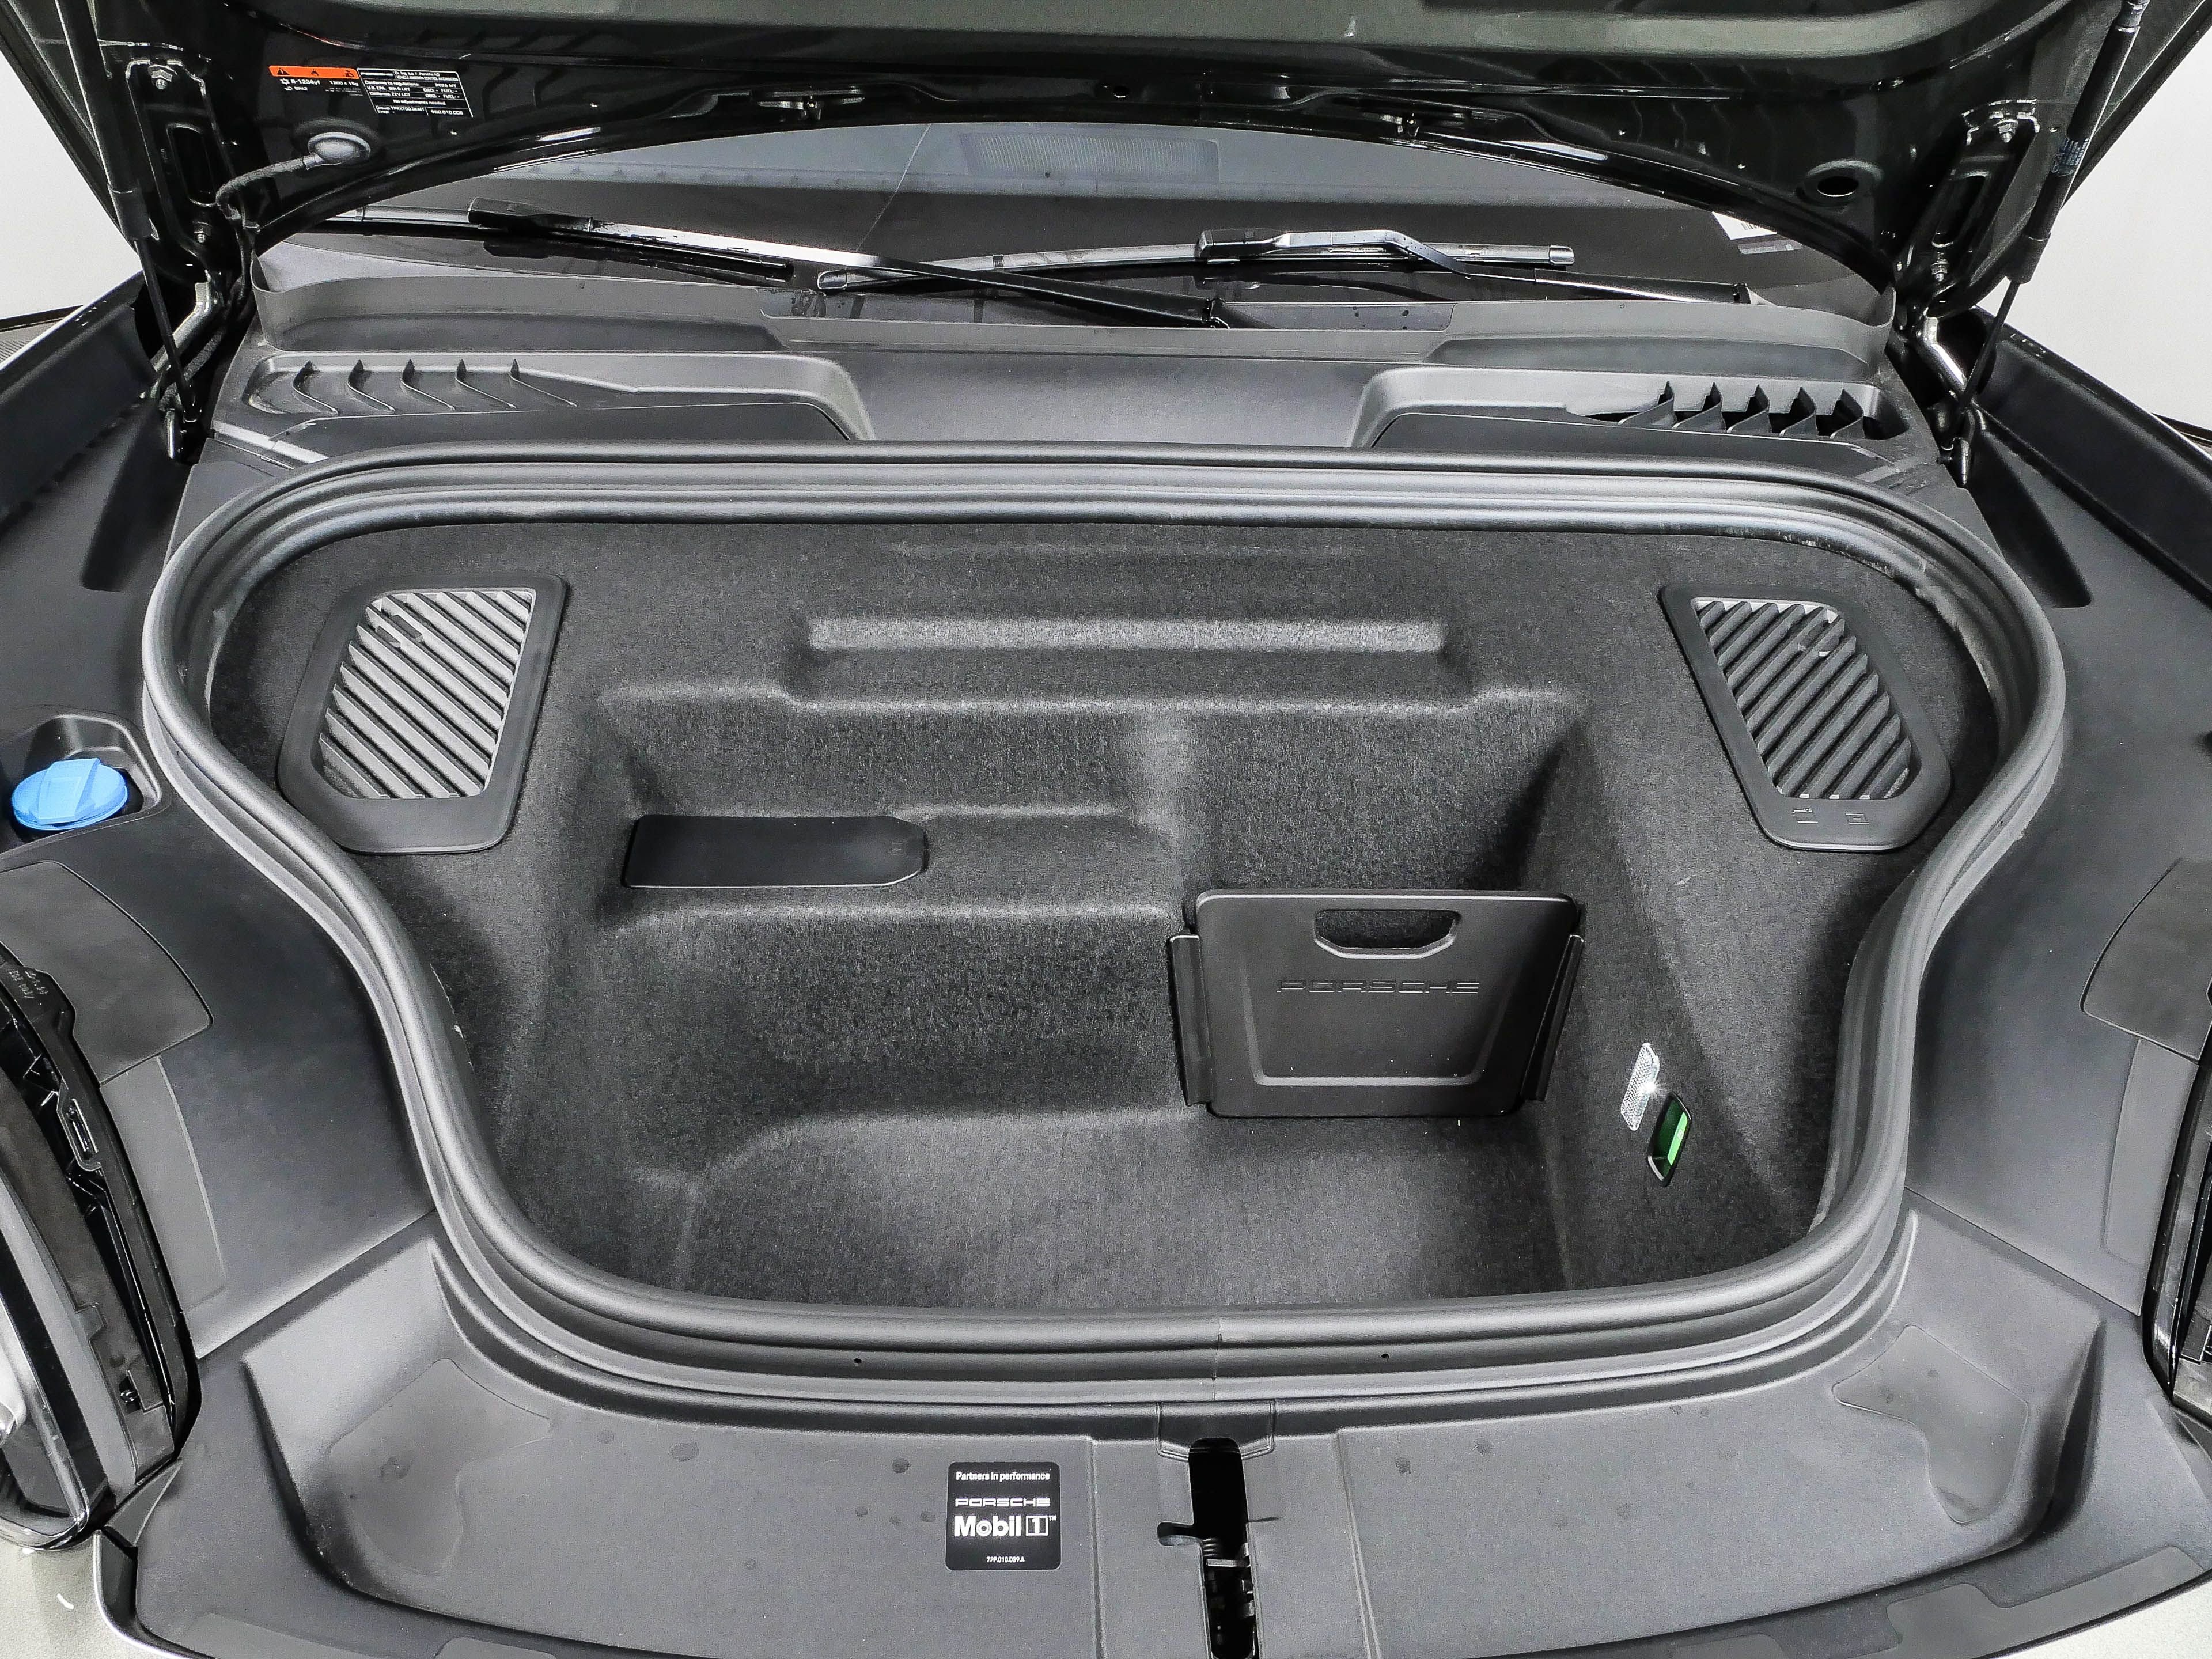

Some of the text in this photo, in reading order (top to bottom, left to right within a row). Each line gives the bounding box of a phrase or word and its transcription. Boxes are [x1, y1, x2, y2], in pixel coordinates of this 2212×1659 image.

[1276, 980, 1480, 994] PORSCHE
[956, 1471, 1050, 1482] Partners in performance
[955, 1497, 1051, 1508] PORSCHE
[954, 1515, 1022, 1536] Mobil
